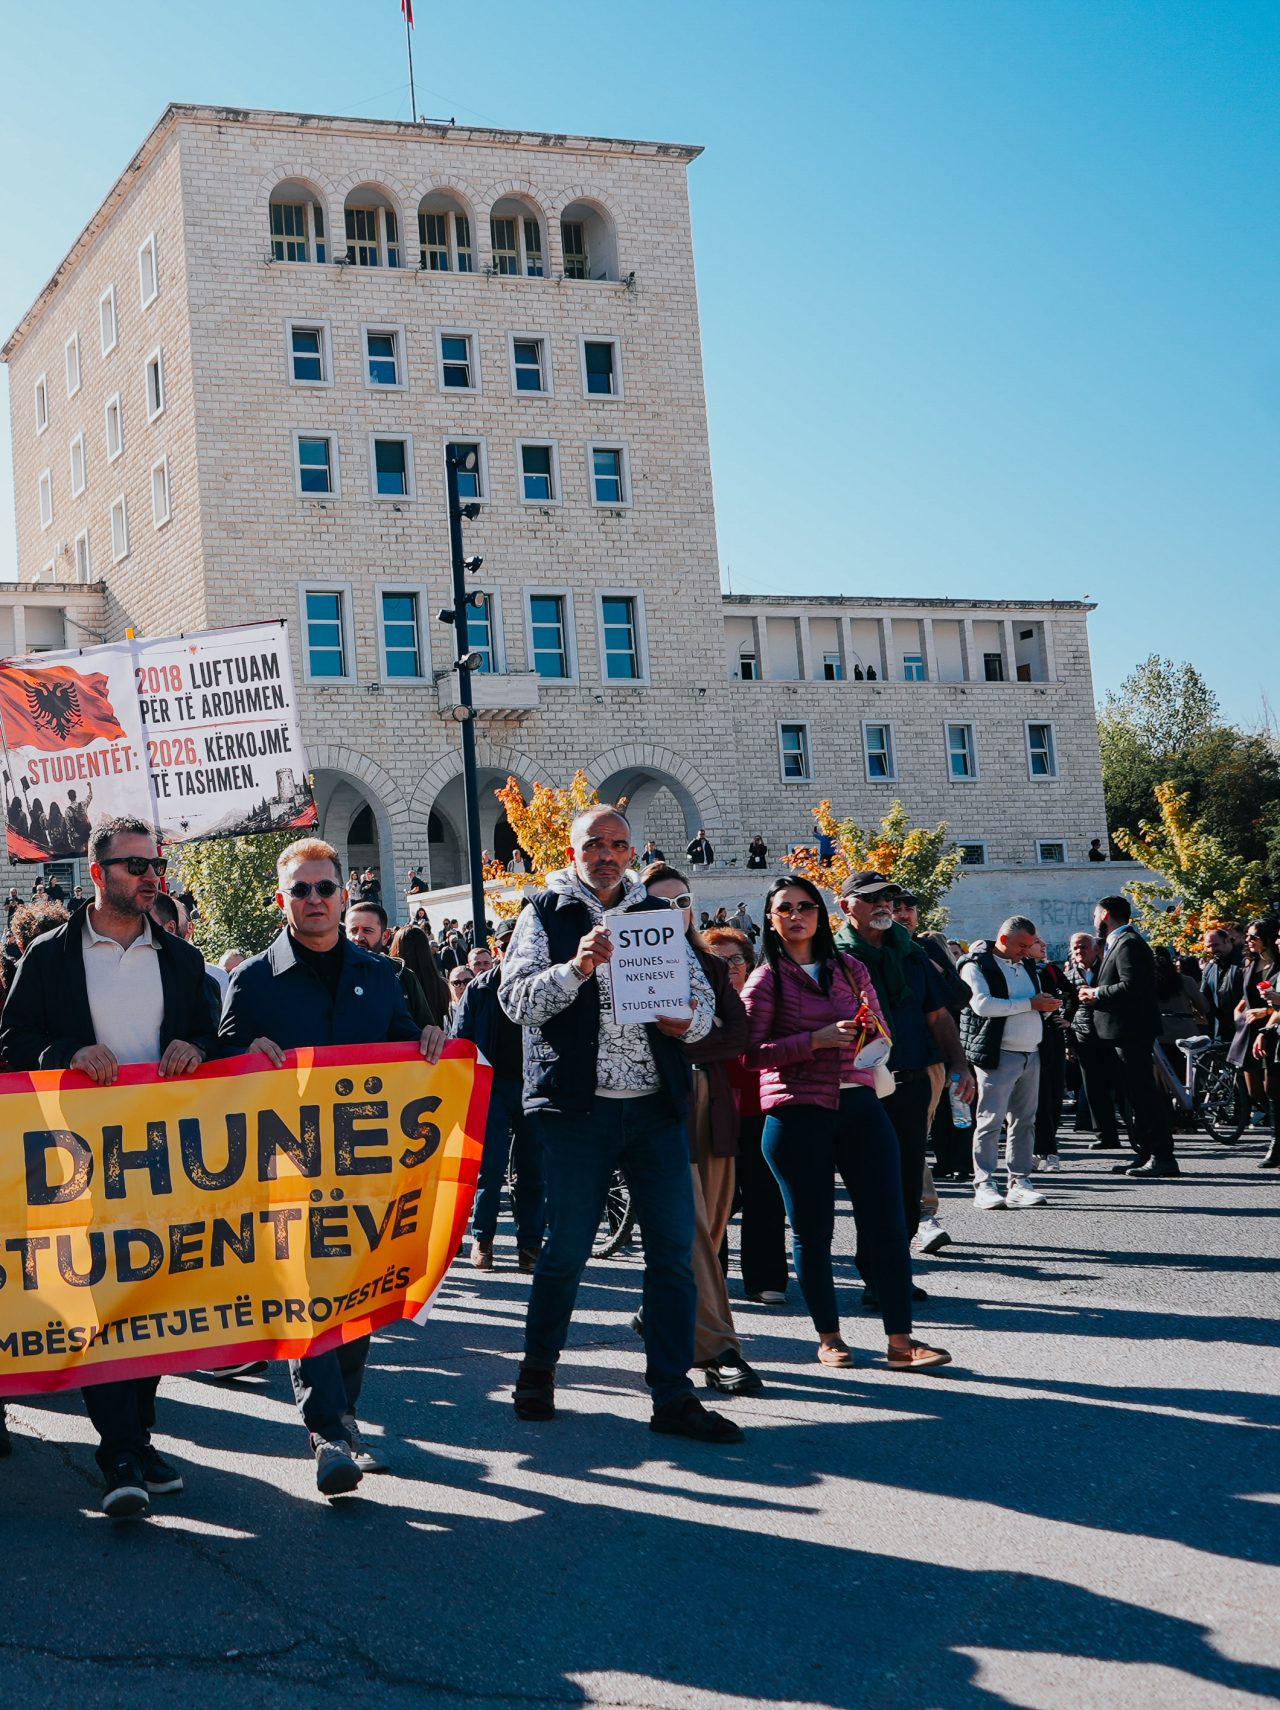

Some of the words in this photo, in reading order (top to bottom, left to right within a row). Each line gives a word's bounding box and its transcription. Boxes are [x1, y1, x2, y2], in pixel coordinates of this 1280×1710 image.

[135, 663, 183, 695] 2018
[190, 652, 281, 689] LUFTUAM
[139, 694, 171, 725] PËR
[177, 692, 196, 721] TË
[202, 685, 290, 719] ARDHMEN.
[146, 737, 203, 769] 2026,
[205, 723, 292, 763] KËRKOJMË
[28, 745, 140, 786] STUDENTËT:
[151, 770, 170, 799] TË
[175, 764, 259, 798] TASHMEN.
[619, 927, 674, 949] STOP
[619, 956, 663, 968] DHUNES
[625, 970, 675, 982] NXENESVE
[622, 998, 684, 1011] STUDENTEVE
[648, 986, 656, 995] &
[23, 1075, 442, 1206] DHUNËS
[218, 1294, 254, 1330] TË
[262, 1264, 410, 1324] PROTESTËS
